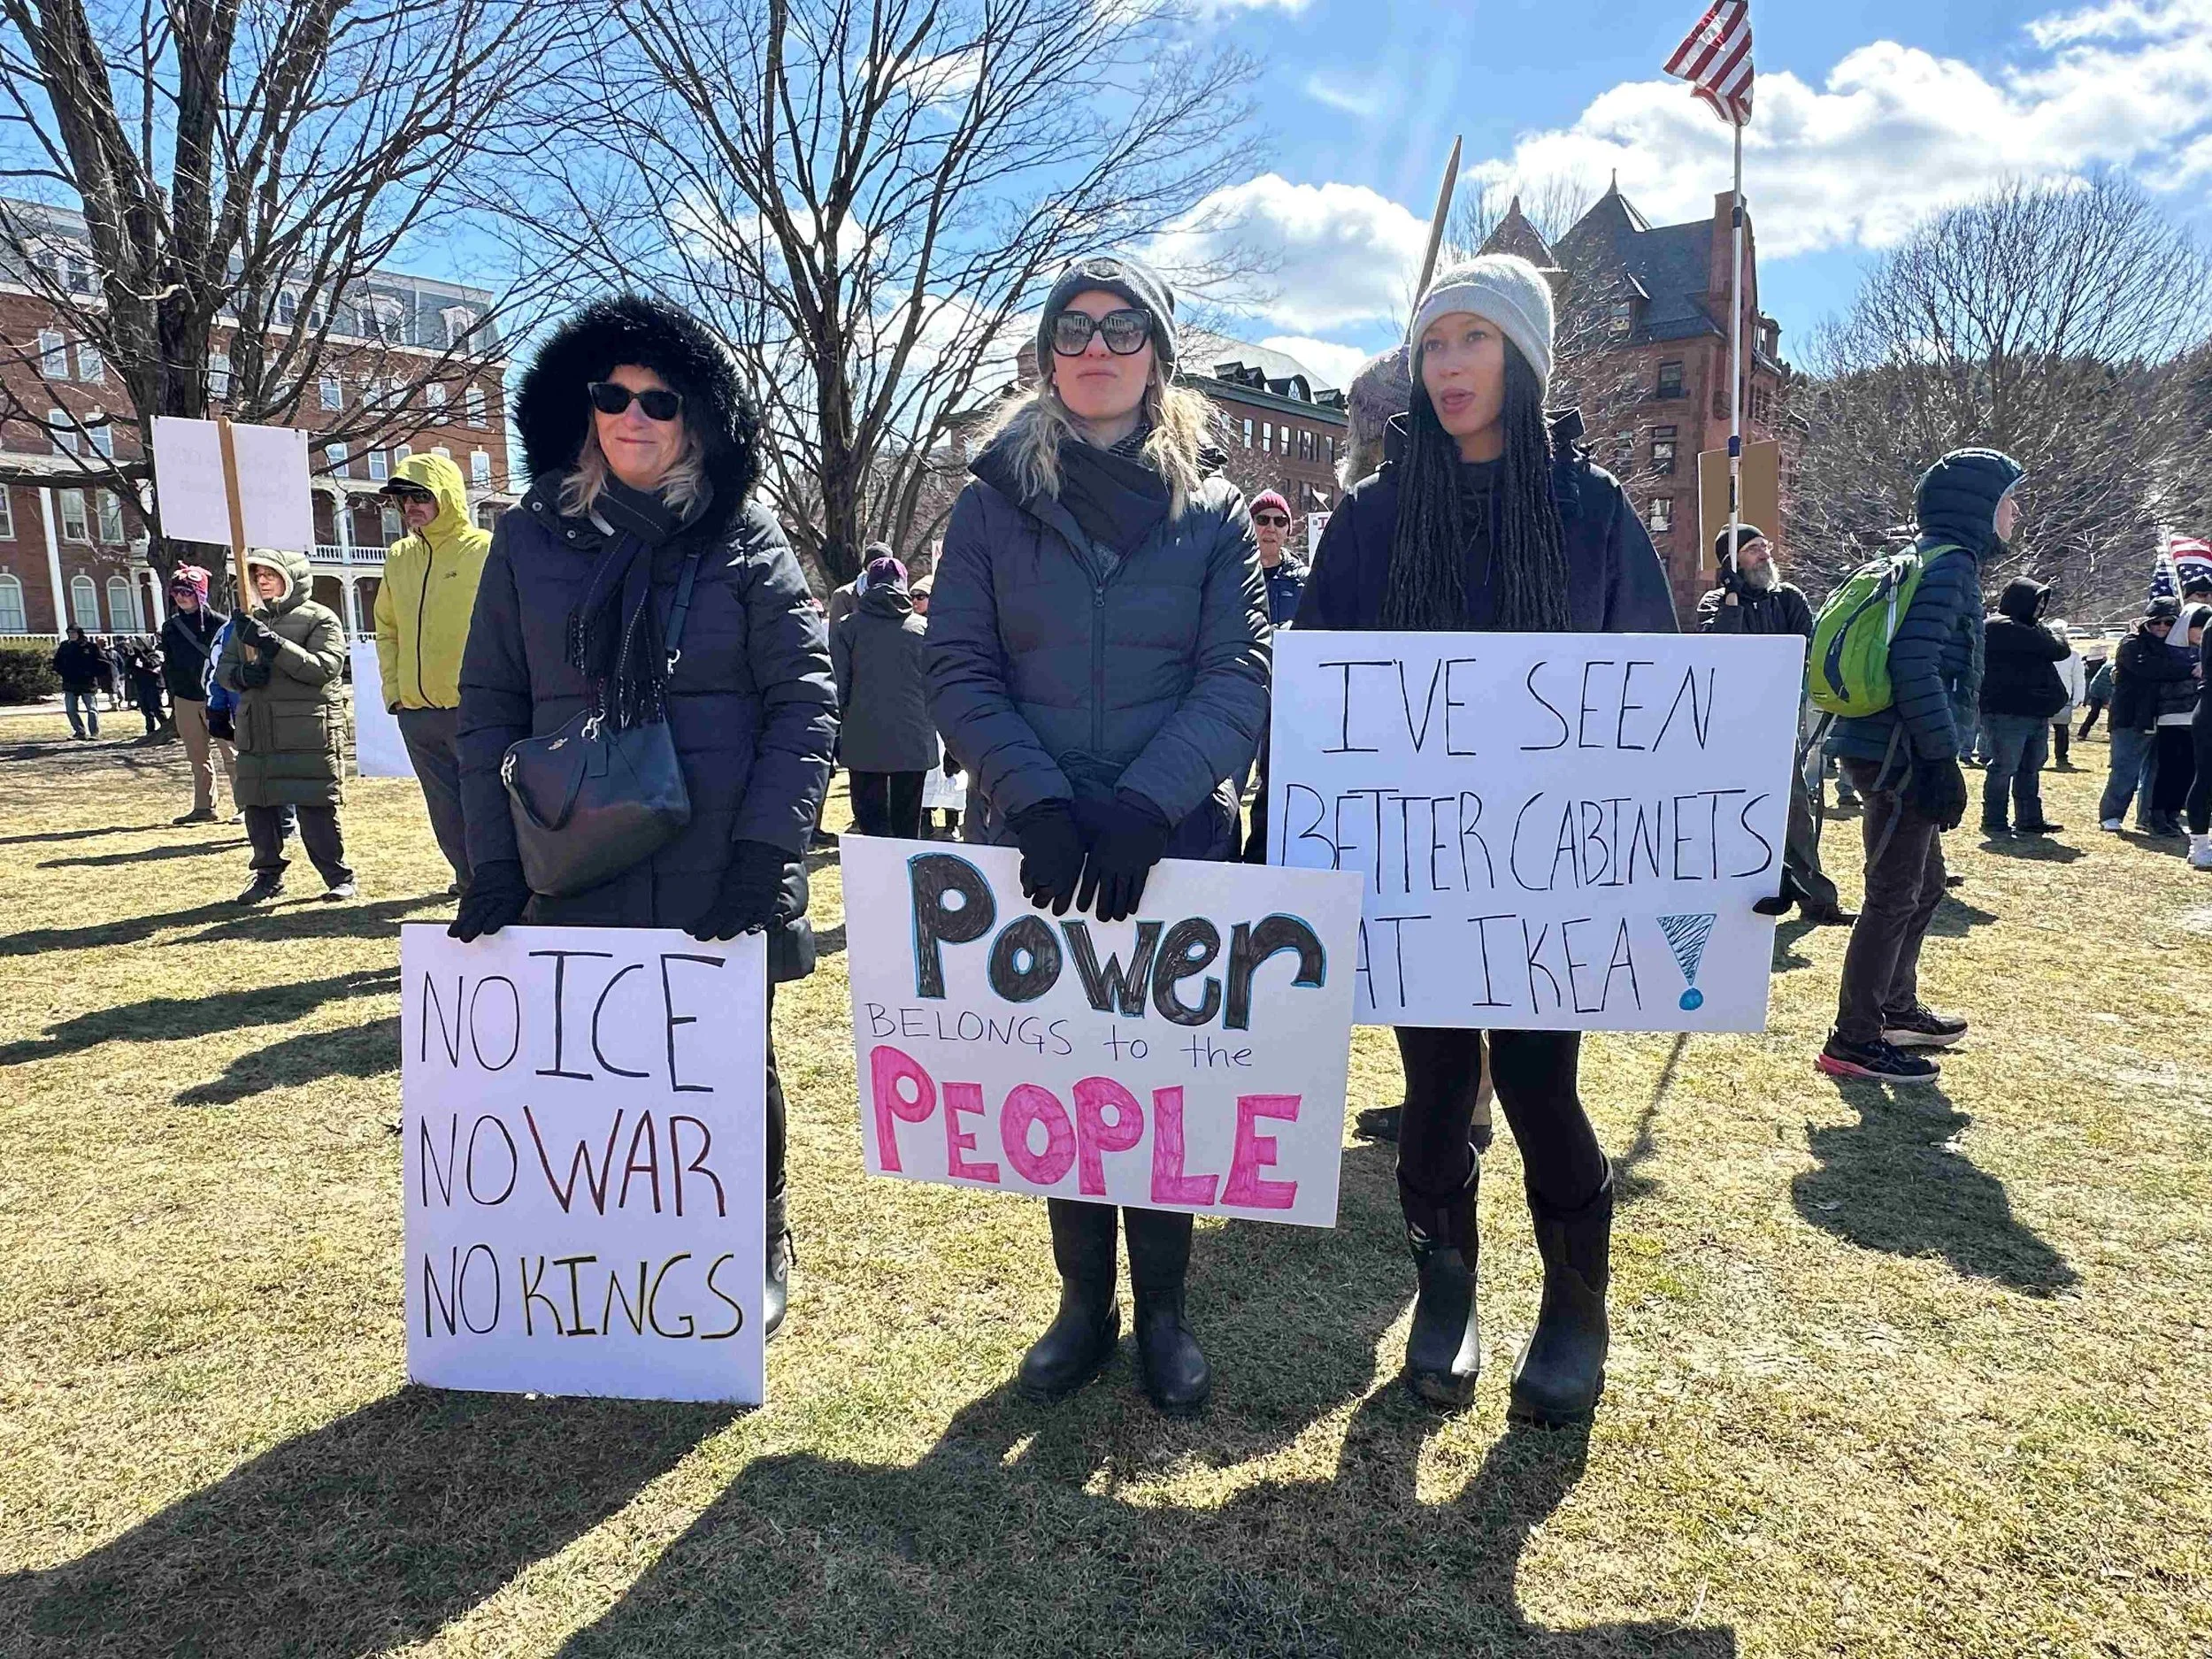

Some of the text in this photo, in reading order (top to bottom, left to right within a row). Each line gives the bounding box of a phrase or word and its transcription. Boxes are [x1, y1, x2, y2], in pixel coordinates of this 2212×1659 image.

[1318, 658, 1716, 756] I'VE SEEN
[1281, 784, 1773, 894] BETTER CABINETS
[907, 852, 1326, 1031] Power
[1356, 915, 1432, 1010] AT
[421, 950, 726, 1093] NO ICE
[864, 1002, 1253, 1068] BELONGS to the
[420, 1104, 726, 1217] NO WAR
[870, 1045, 1302, 1210] PEOPLE
[424, 1244, 744, 1340] NO KINGS
